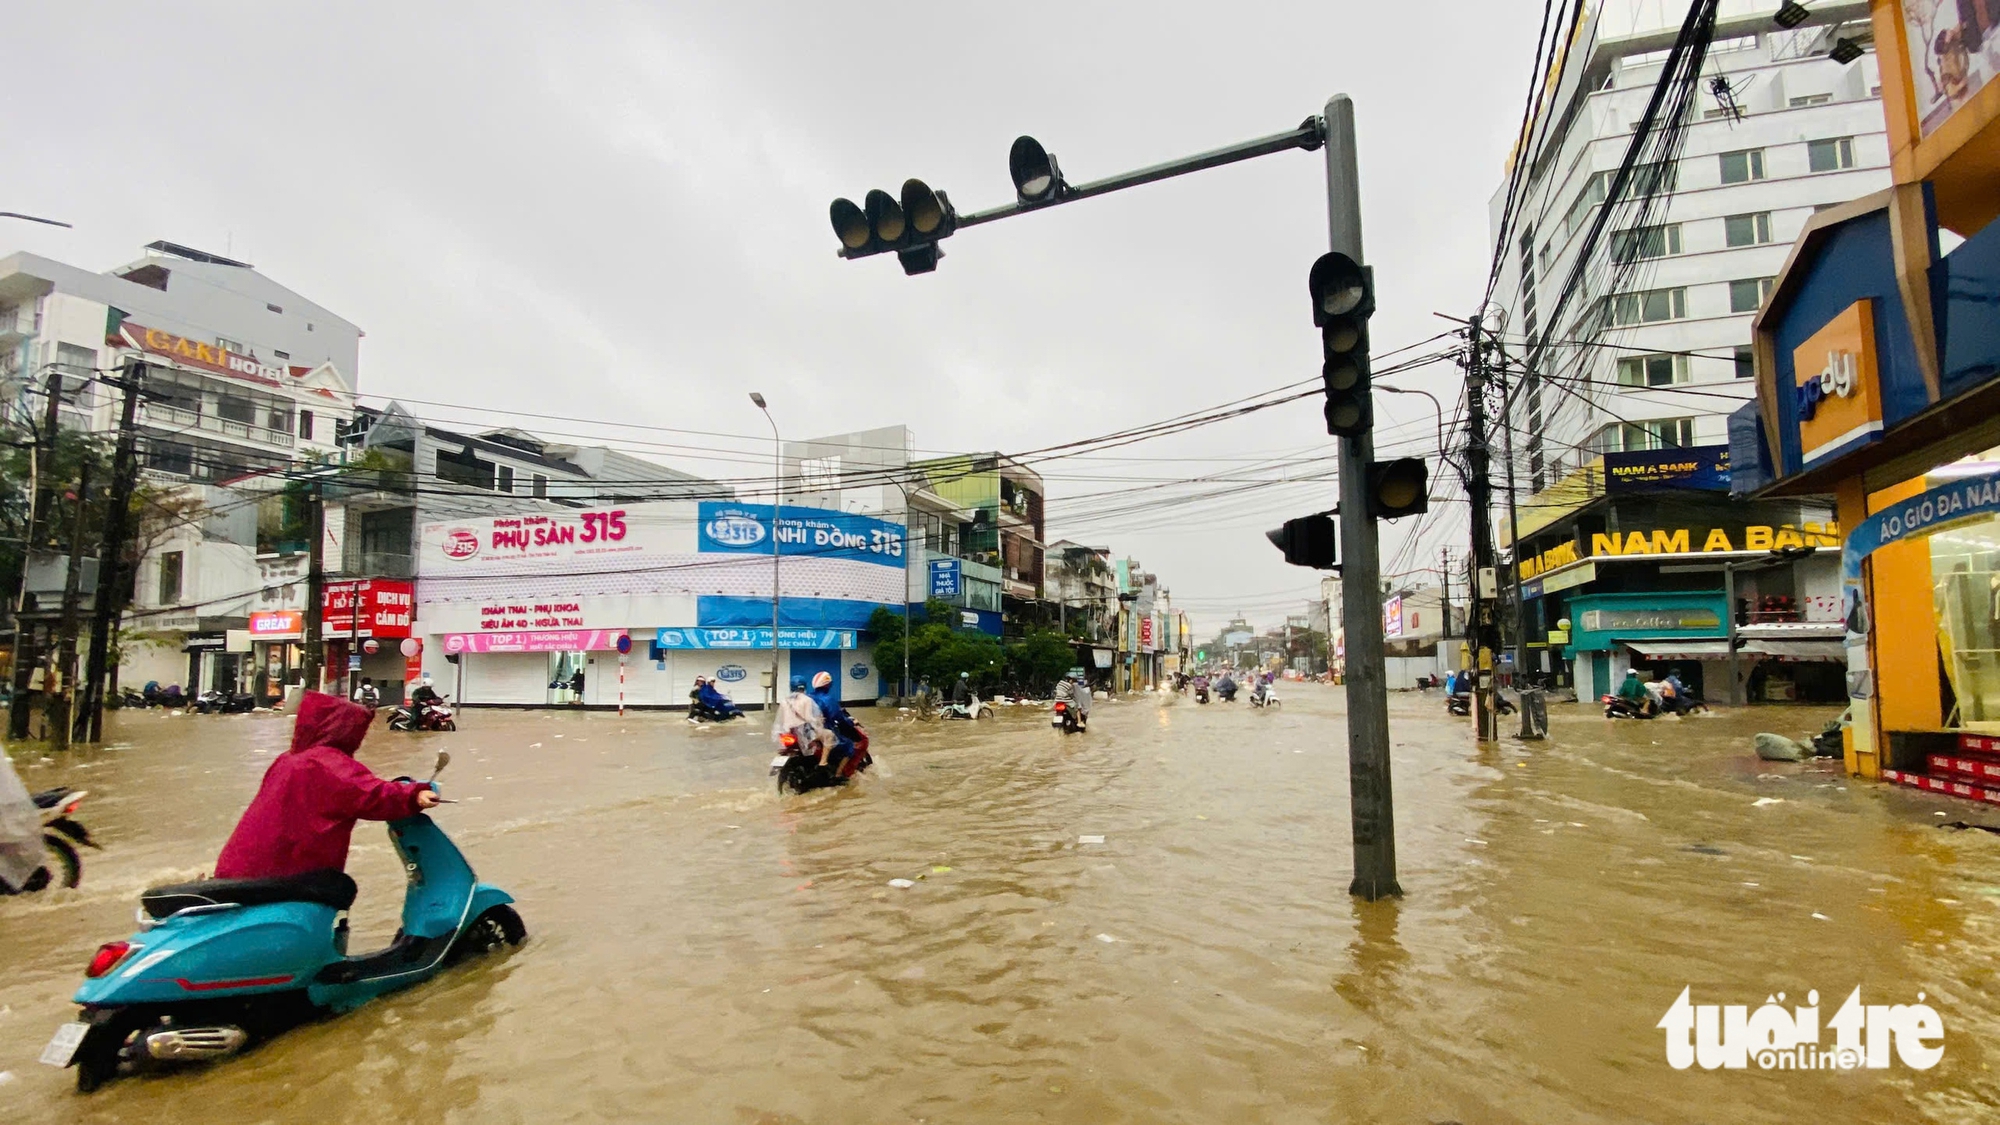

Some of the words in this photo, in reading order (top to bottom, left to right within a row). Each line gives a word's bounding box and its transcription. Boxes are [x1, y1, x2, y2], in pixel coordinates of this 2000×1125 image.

[146, 328, 226, 367] GAKI
[229, 356, 286, 380] HOTEL
[1612, 465, 1645, 476] NAM
[1659, 462, 1698, 473] BANK
[1880, 517, 1901, 542] ÁO
[1904, 496, 1934, 529] GIÓ
[1937, 491, 1963, 517] ĐA
[492, 529, 530, 551] PHỤ
[534, 520, 574, 547] SẢN
[579, 510, 626, 543] 315
[731, 523, 758, 541] 315
[457, 541, 475, 553] 315
[773, 526, 806, 544] NHI
[814, 524, 866, 551] ĐỒNG
[869, 529, 902, 557] 315
[1592, 529, 1689, 556] NAM
[1703, 528, 1733, 552] A
[1544, 539, 1578, 571] BANK
[377, 591, 398, 607] DỊCH
[507, 604, 527, 614] THAI
[553, 603, 580, 613] KHOA
[257, 617, 292, 631] GREAT
[561, 617, 583, 627] THAI
[492, 634, 513, 644] TOP
[516, 634, 522, 644] 1
[710, 630, 738, 640] TOP
[741, 630, 749, 640] 1
